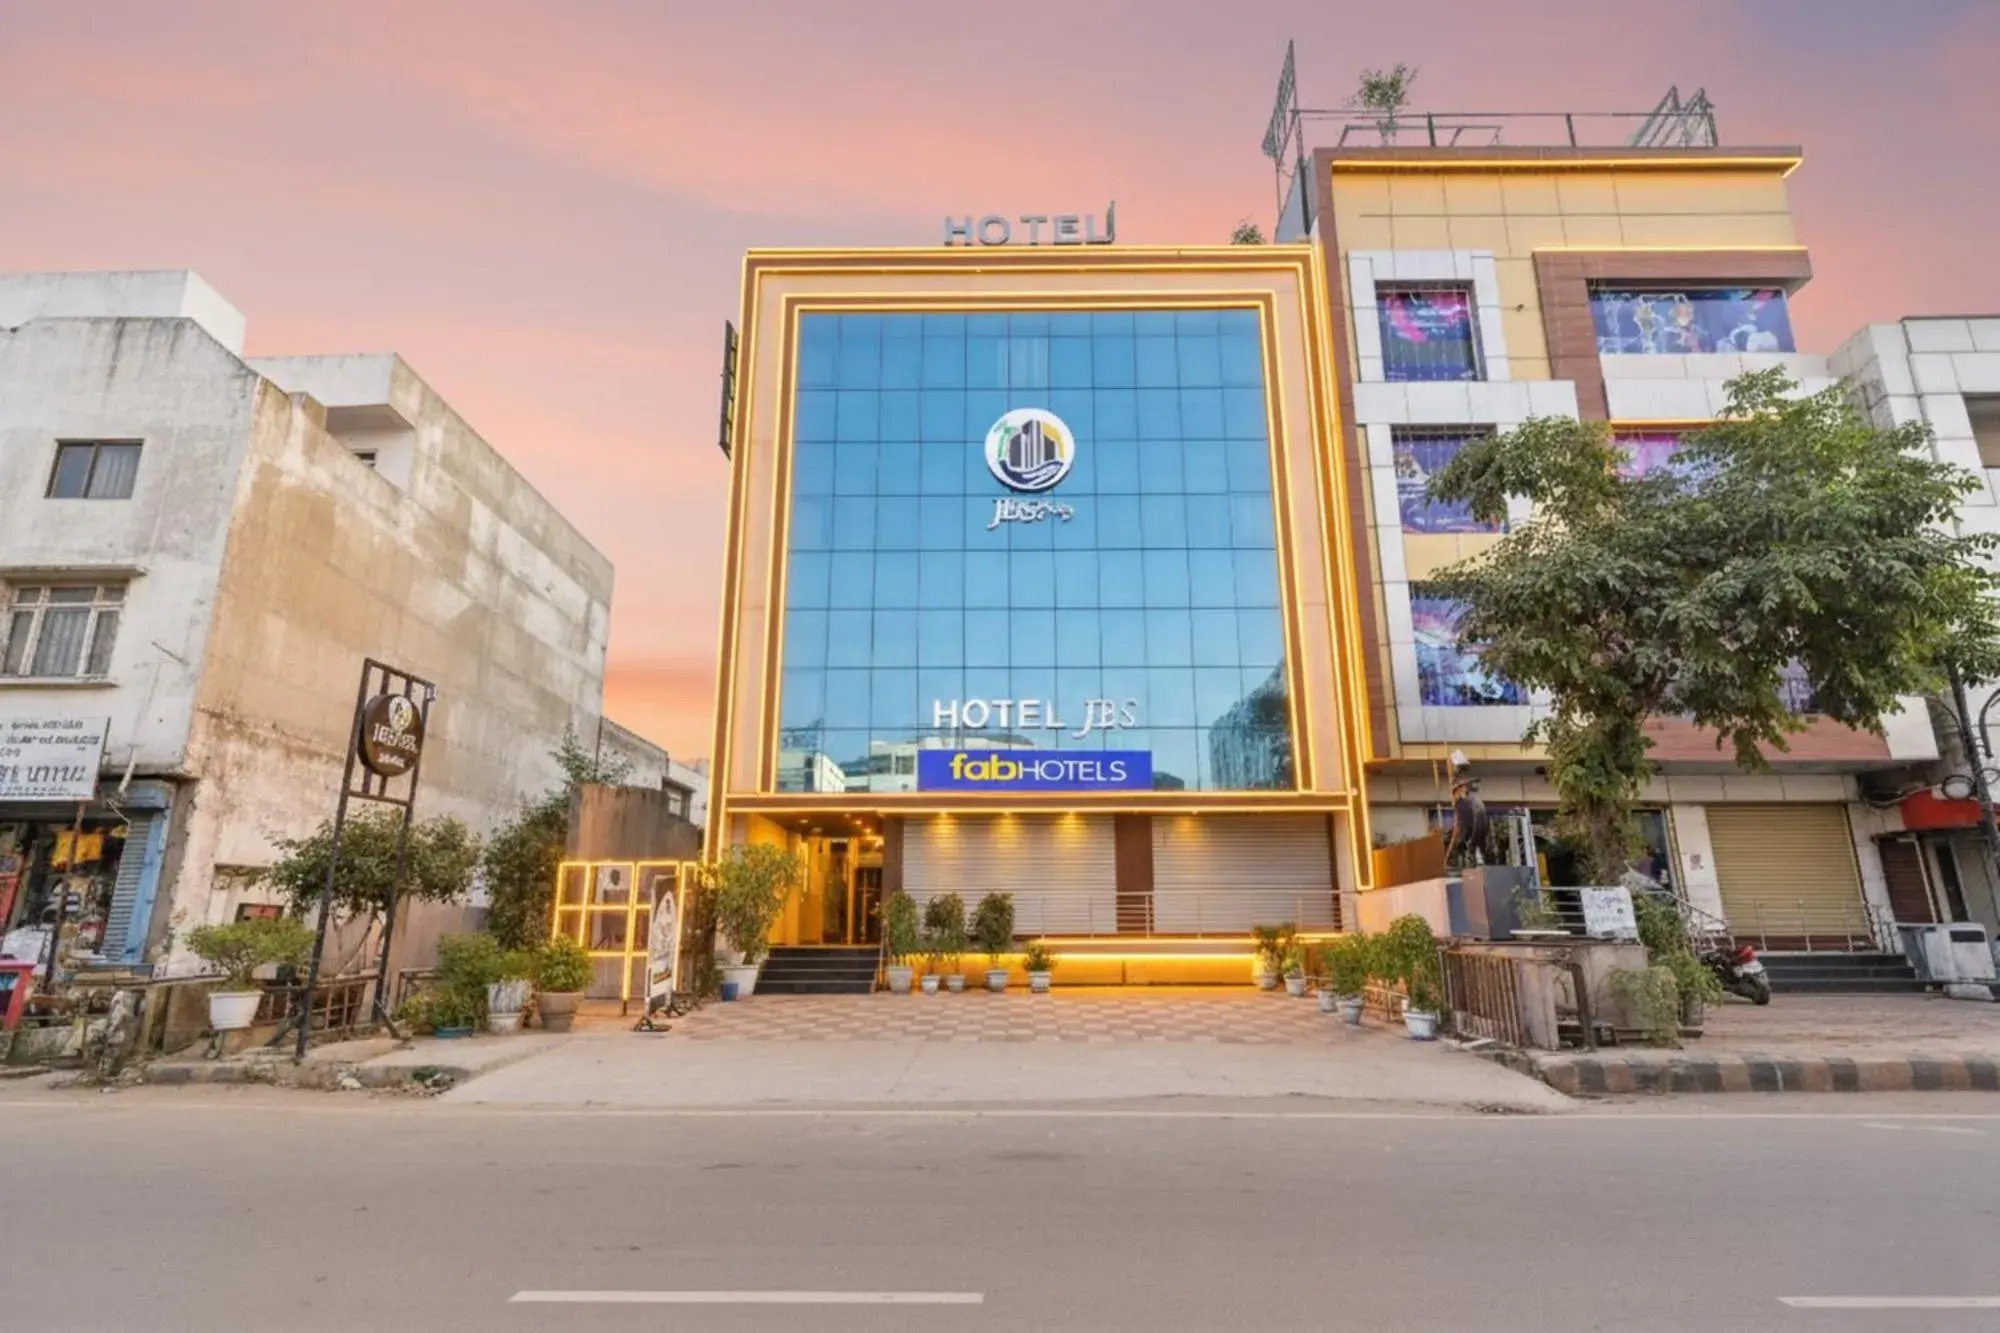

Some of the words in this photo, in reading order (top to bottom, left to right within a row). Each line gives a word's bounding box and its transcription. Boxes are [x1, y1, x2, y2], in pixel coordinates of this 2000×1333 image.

[944, 214, 1113, 246] HOTEL
[933, 699, 1066, 729] HOTEL
[1072, 698, 1138, 739] JBS
[949, 753, 1128, 782] fabHOTELS
